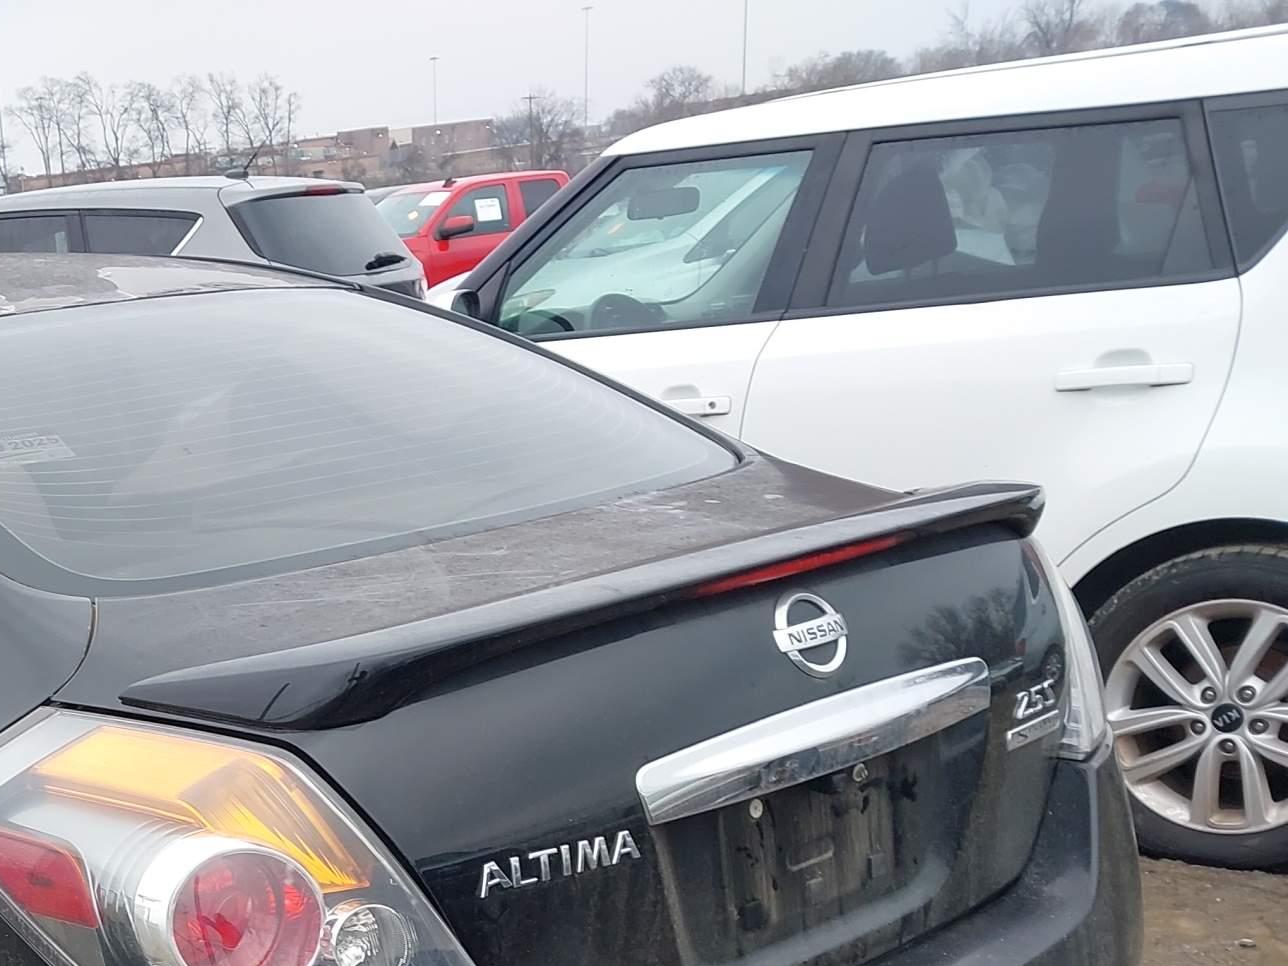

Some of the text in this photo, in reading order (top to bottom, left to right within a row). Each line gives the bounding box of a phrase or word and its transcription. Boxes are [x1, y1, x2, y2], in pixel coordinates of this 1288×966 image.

[787, 618, 844, 646] NISSAN
[1212, 708, 1241, 728] KIA
[478, 829, 642, 899] ALTIMA
